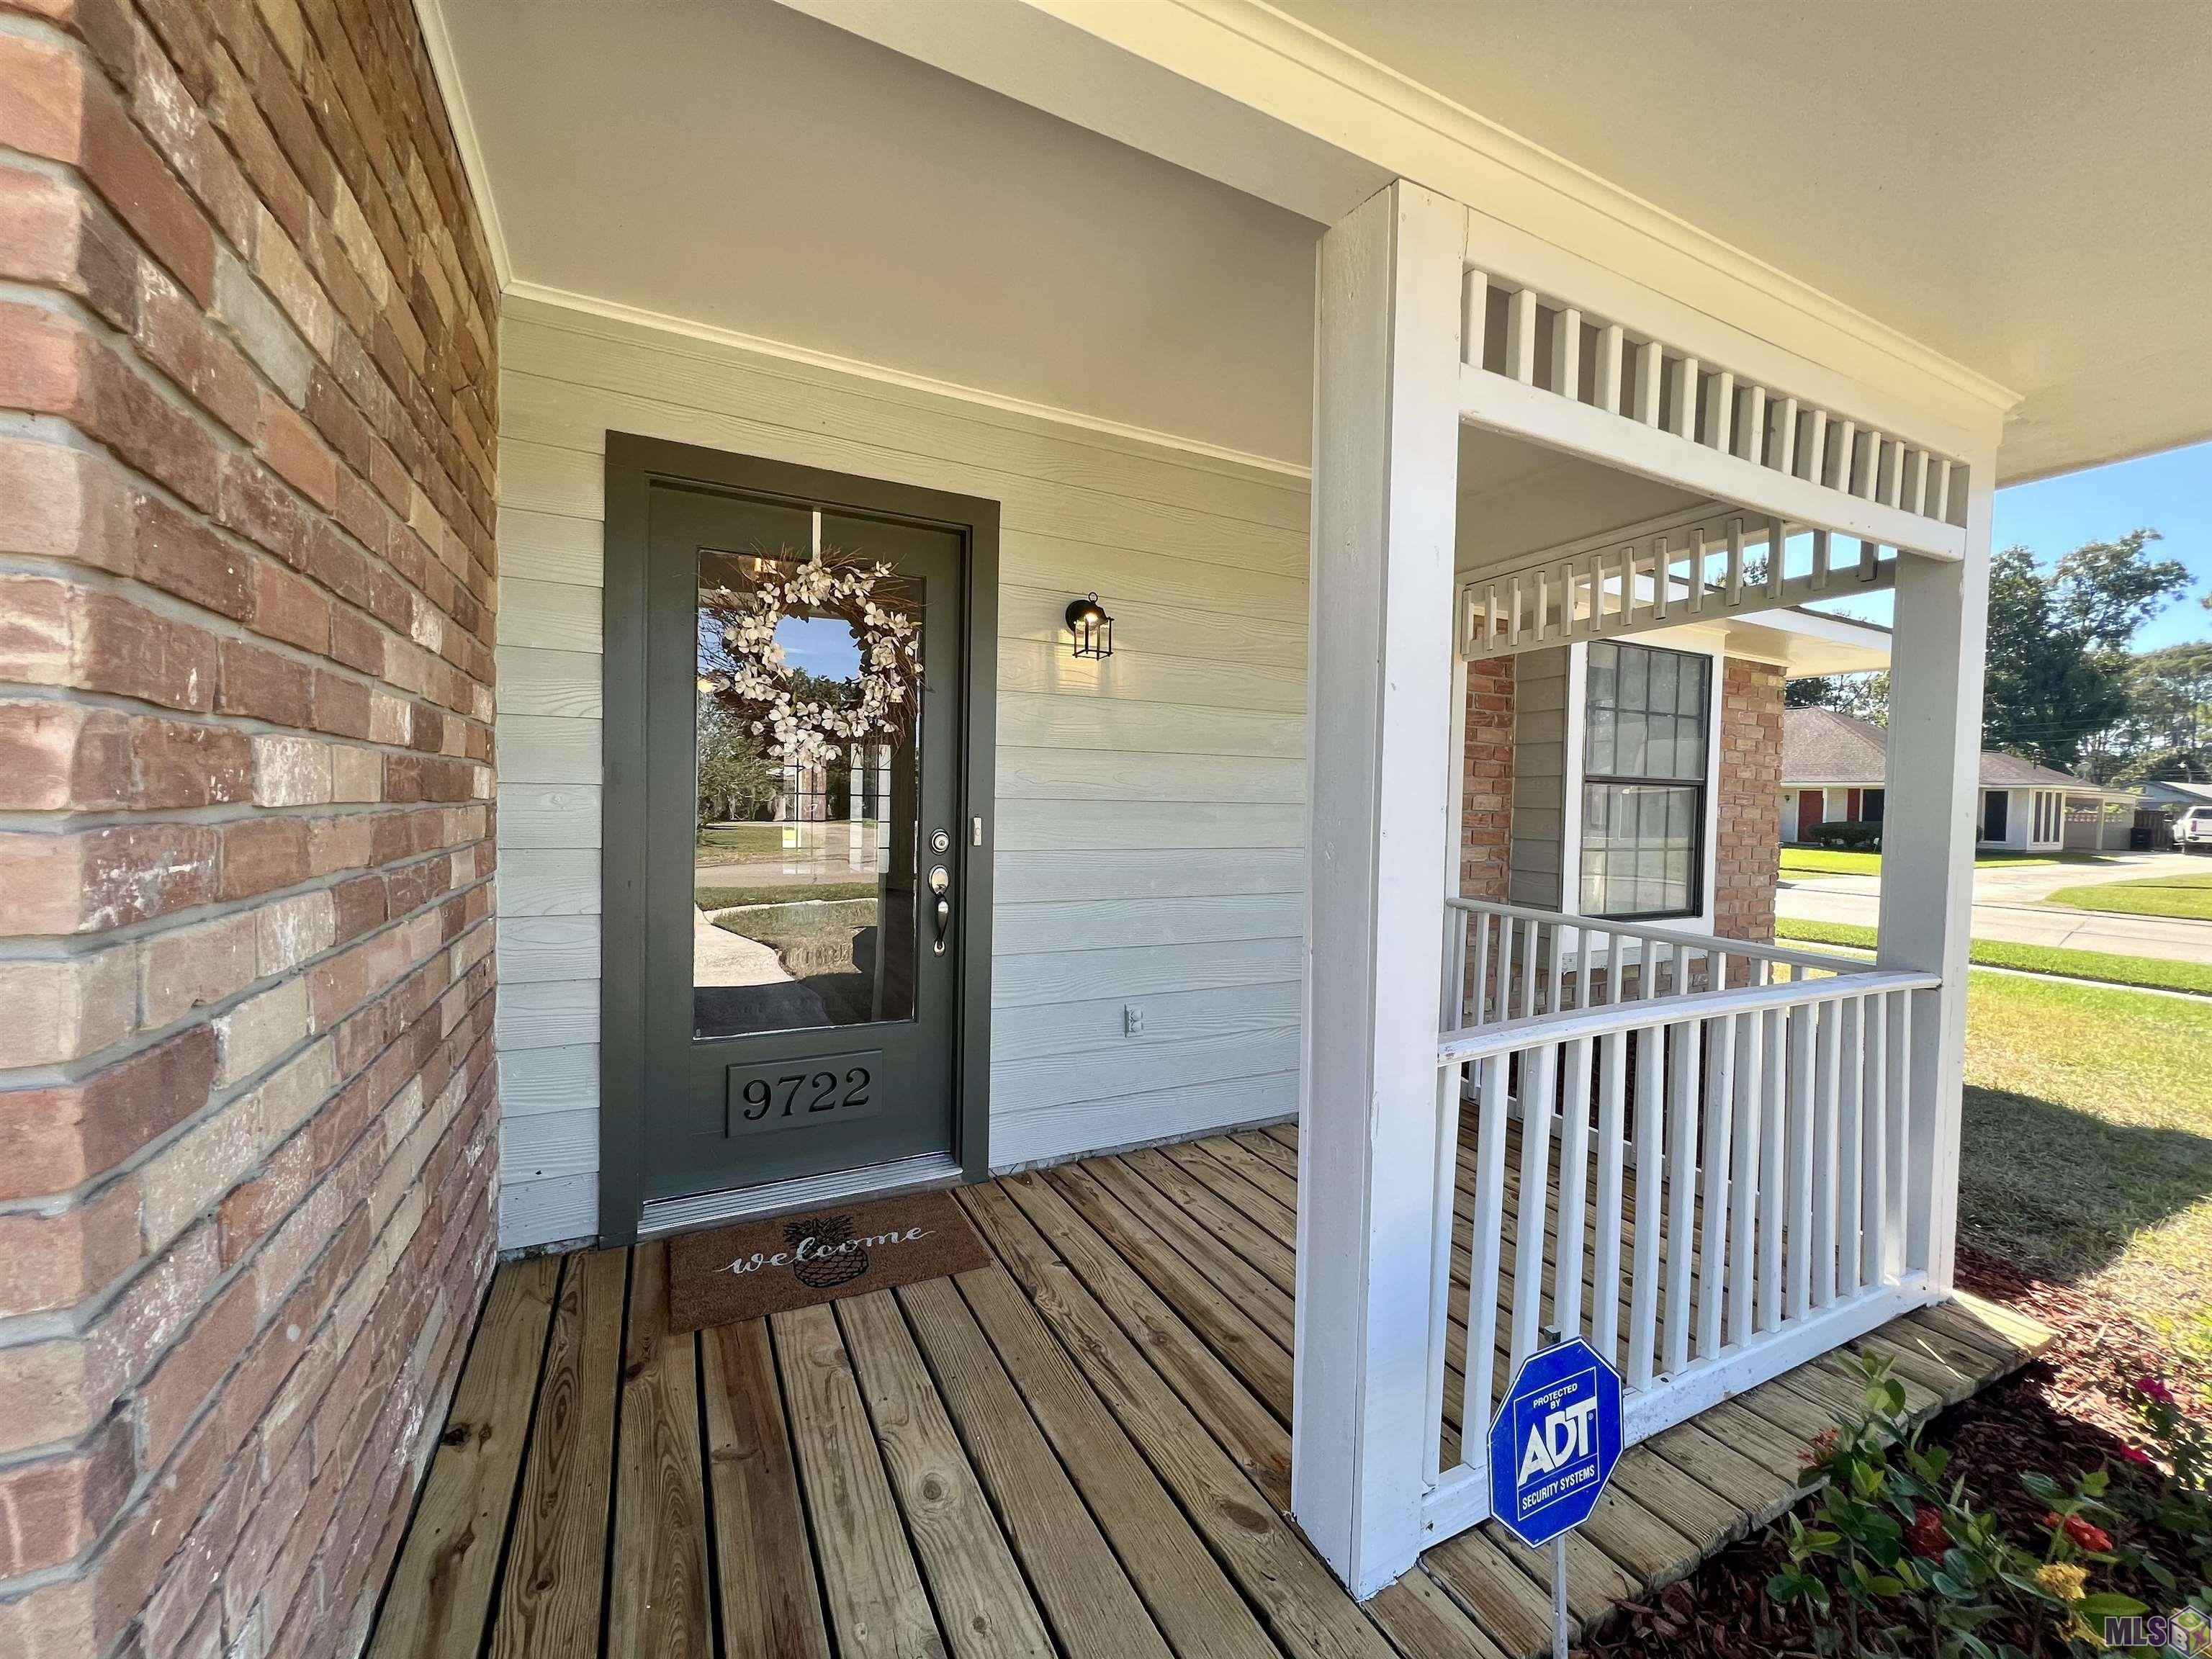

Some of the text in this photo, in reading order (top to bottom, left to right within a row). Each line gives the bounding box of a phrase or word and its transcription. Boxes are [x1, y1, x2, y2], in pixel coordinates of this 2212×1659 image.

[742, 1066, 871, 1121] 9722
[714, 1226, 936, 1274] welcome
[1533, 1382, 1578, 1408] PROTECTED
[1550, 1398, 1561, 1410] BY
[1518, 1395, 1597, 1485] ADT
[1522, 1465, 1596, 1511] SECURITY SYSTEMS
